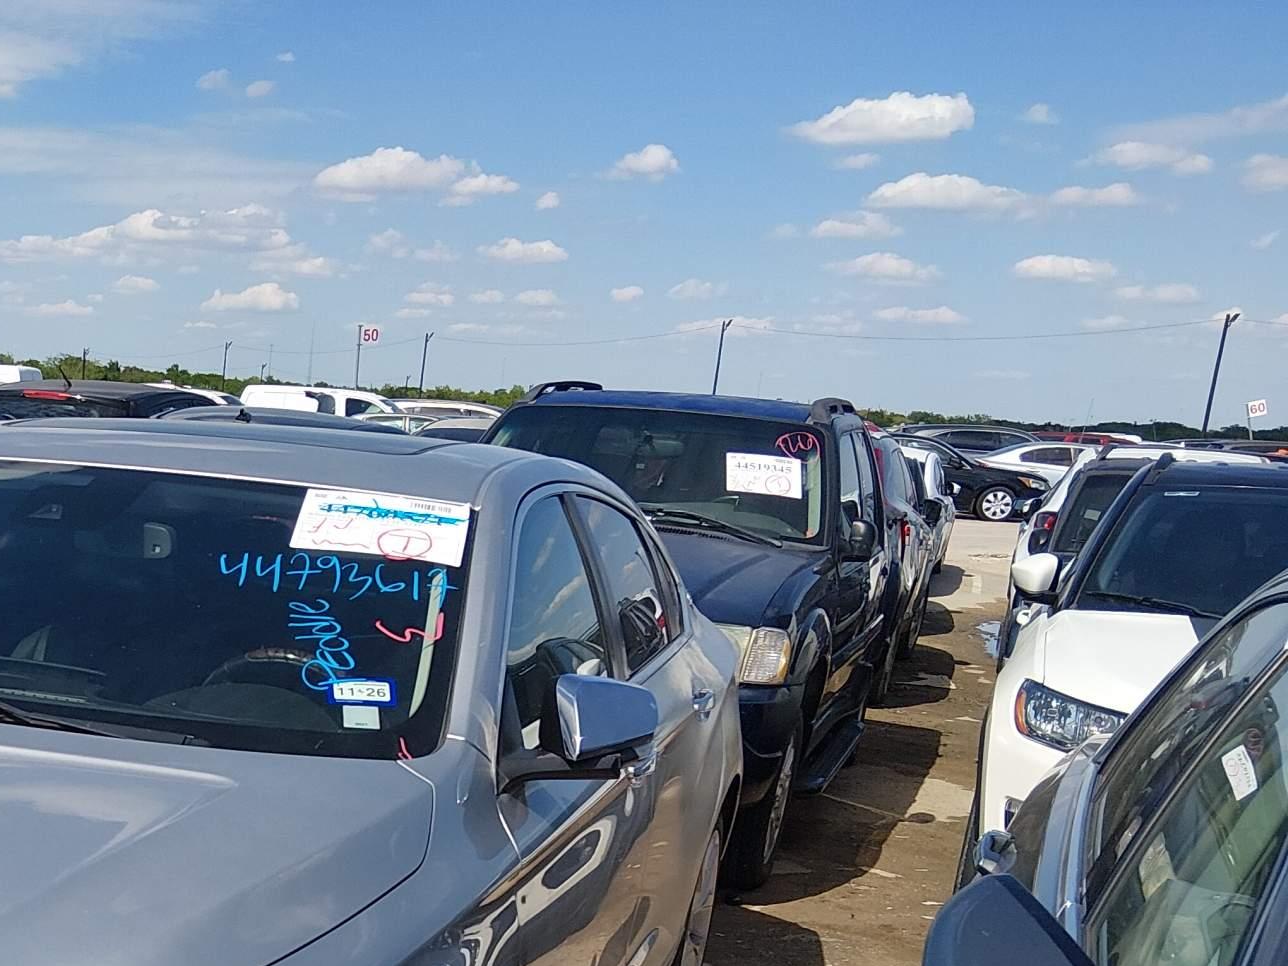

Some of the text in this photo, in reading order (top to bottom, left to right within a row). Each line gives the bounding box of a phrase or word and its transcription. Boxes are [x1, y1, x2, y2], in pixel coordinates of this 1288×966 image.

[363, 328, 379, 342] 50
[1250, 402, 1265, 415] 60
[220, 552, 459, 609] 44793617
